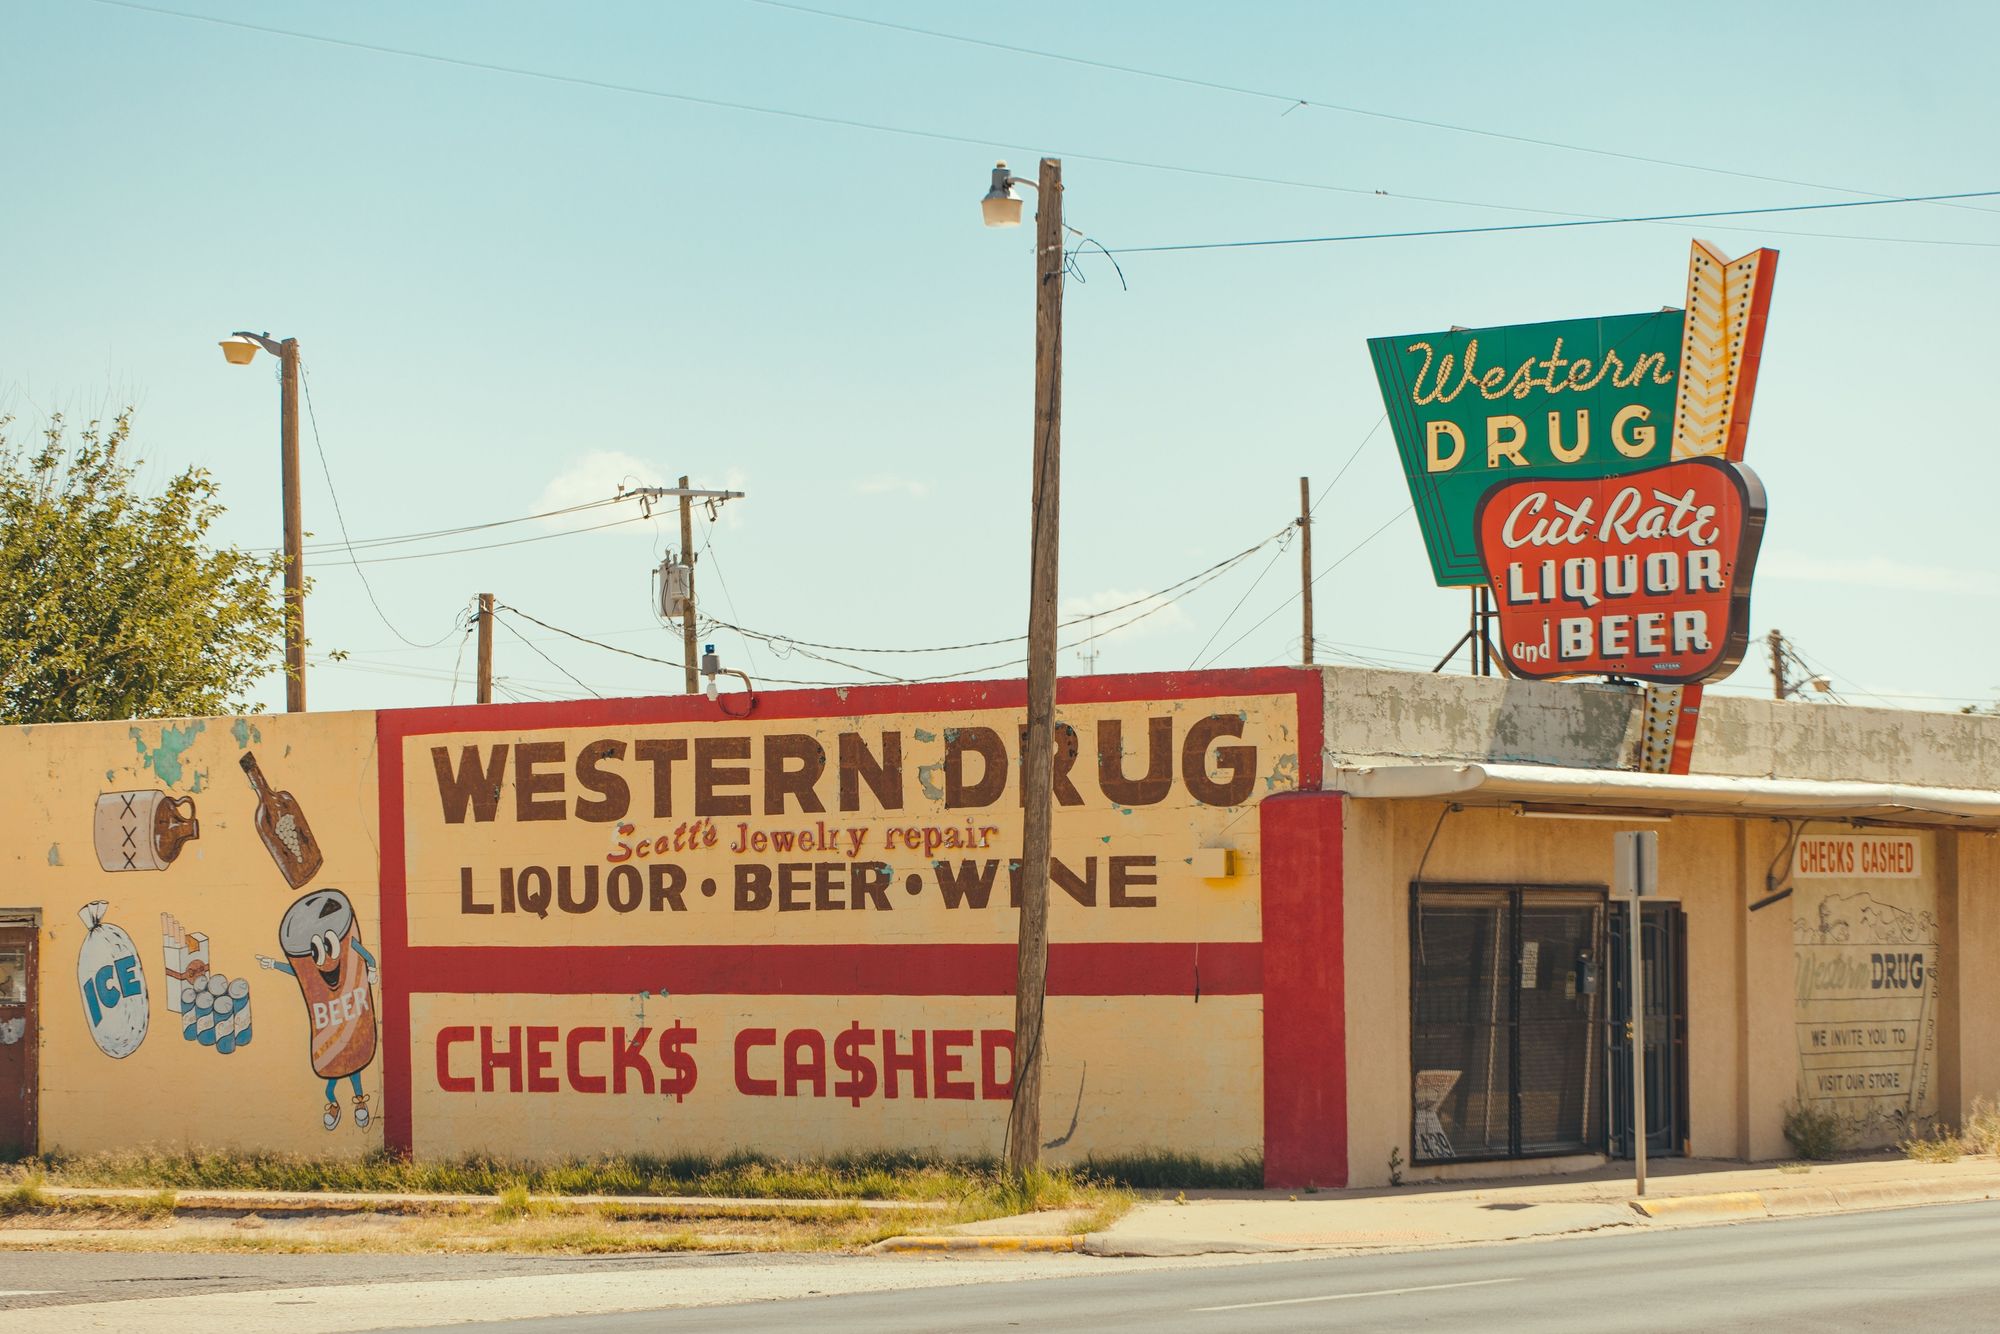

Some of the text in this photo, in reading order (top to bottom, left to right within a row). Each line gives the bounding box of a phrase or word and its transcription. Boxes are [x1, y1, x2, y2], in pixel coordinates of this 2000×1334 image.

[1406, 337, 1674, 406] Western
[1425, 404, 1657, 474] DRUG
[1501, 486, 1719, 549] Cut Rate
[1507, 548, 1725, 607] LIQUOR
[1512, 609, 1713, 664] and BEER
[430, 713, 1259, 824] WESTERN DRUG
[884, 816, 999, 859] repair
[1799, 839, 1914, 874] CHECKS CASHED
[460, 854, 1158, 920] LIQUOR BEER WINE
[83, 955, 142, 1027] ICE
[1870, 951, 1924, 990] DRUG
[312, 987, 370, 1031] BEER
[1811, 1027, 1907, 1048] WE INVITE YOU TO
[435, 1018, 1018, 1109] CHECK$ CA$HED
[1816, 1072, 1901, 1093] VISIT OUR STORE
